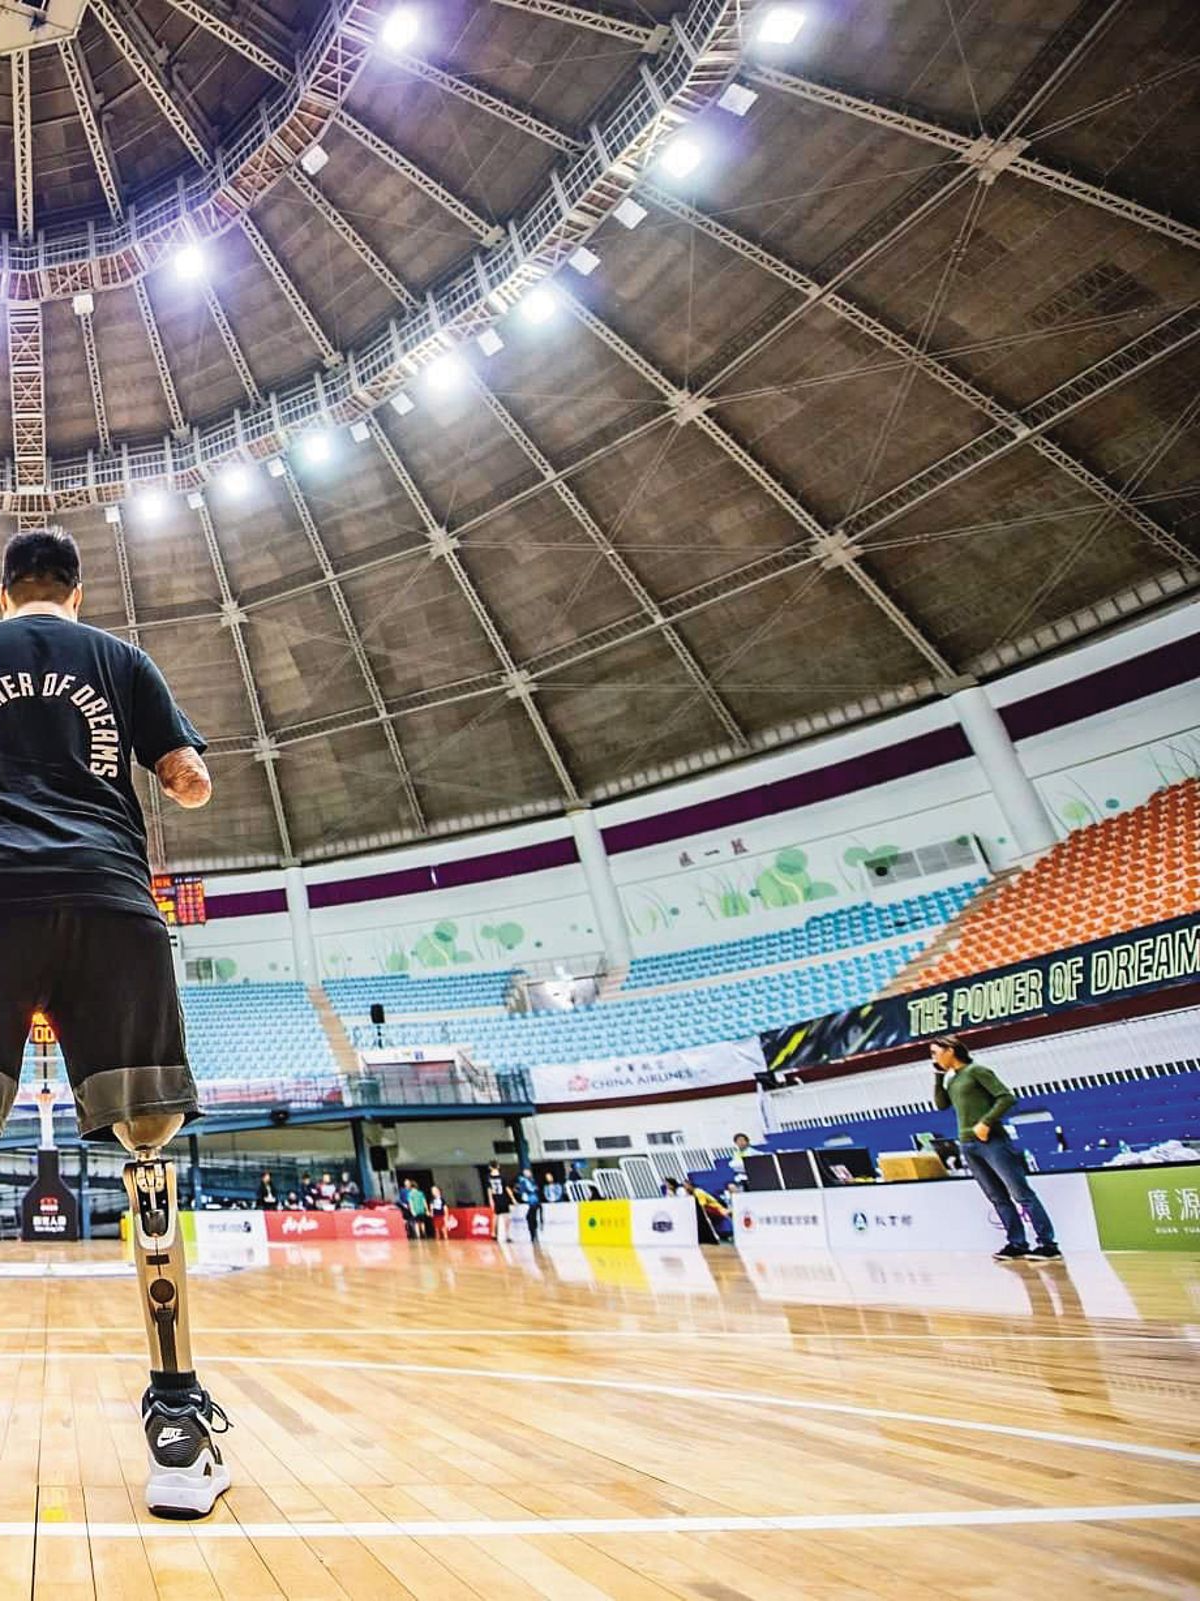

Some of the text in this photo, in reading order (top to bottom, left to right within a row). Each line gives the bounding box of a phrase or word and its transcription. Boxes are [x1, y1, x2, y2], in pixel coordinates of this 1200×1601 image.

[42, 673, 76, 697] OF
[69, 684, 119, 778] DREAMS
[908, 992, 948, 1036] THE
[951, 969, 1043, 1027] POWER
[1050, 956, 1084, 1005] OF
[637, 1069, 693, 1086] AIRLINES
